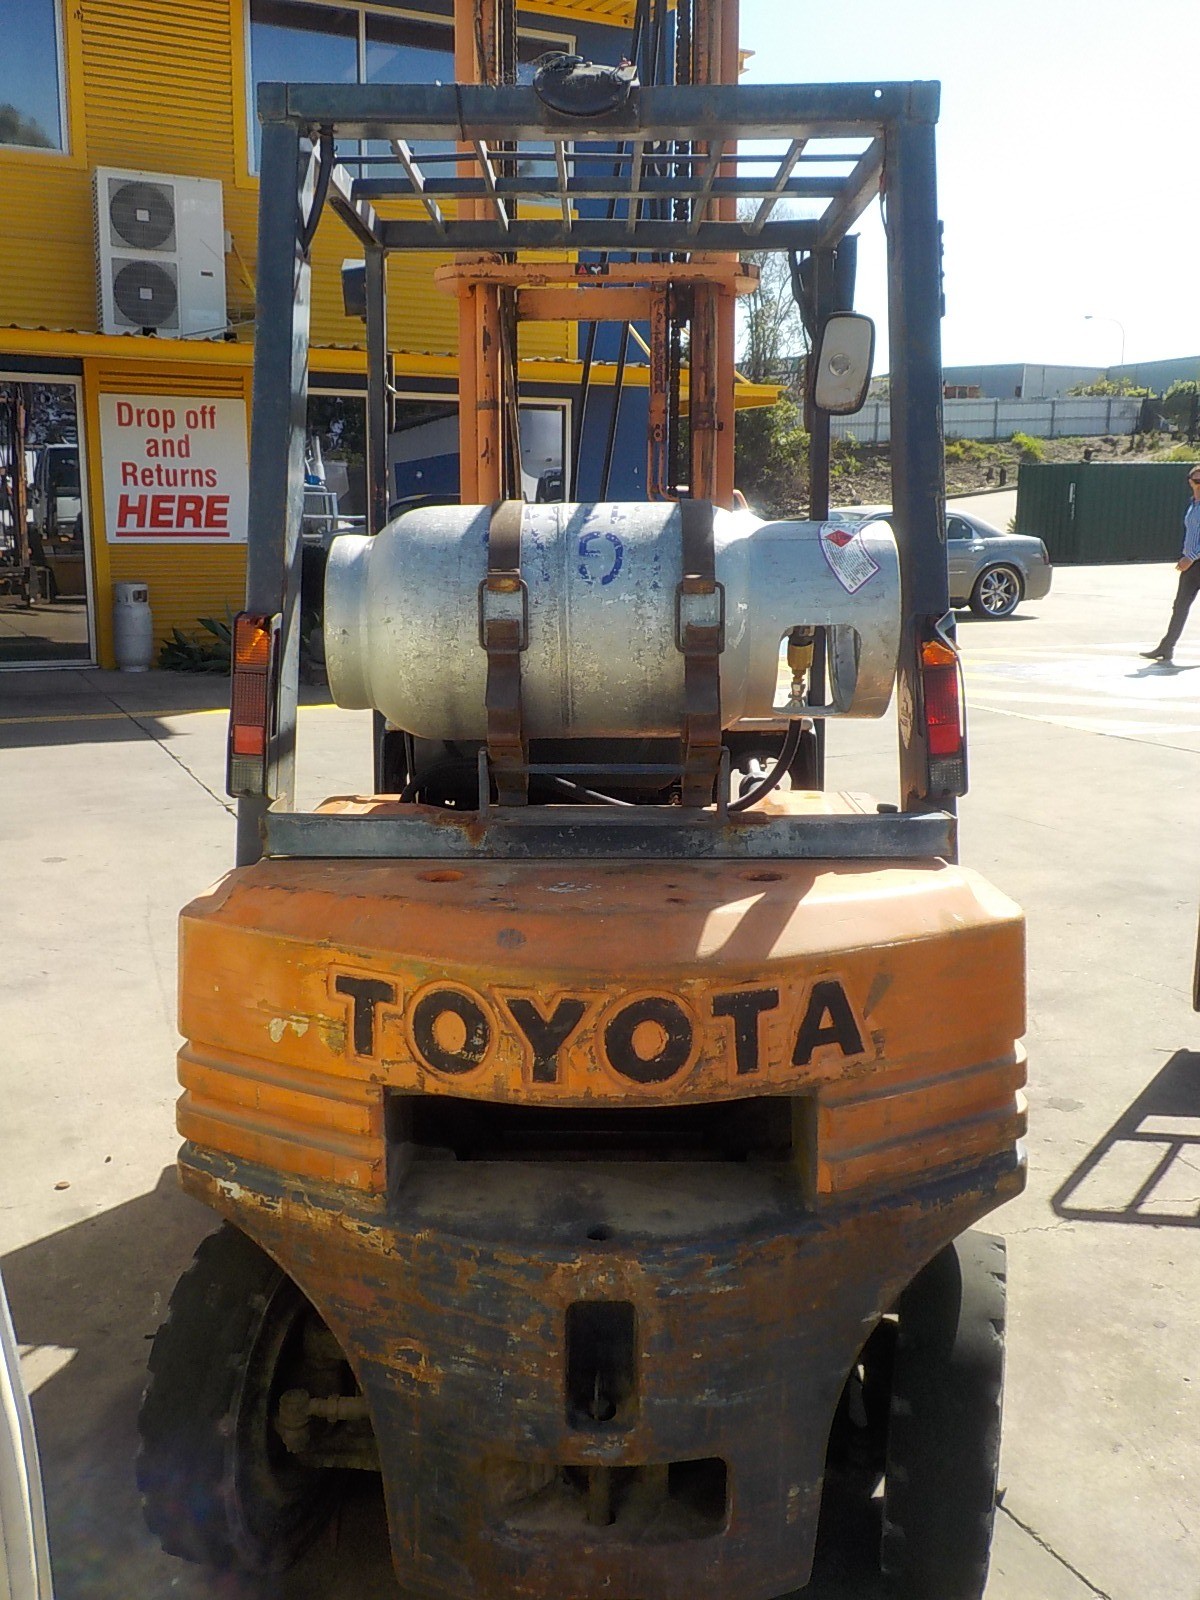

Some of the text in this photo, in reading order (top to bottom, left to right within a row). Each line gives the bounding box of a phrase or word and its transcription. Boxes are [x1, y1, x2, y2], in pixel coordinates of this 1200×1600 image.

[116, 401, 216, 434] Drop off
[145, 433, 191, 458] and
[121, 461, 218, 488] Returns
[117, 494, 230, 528] HERE
[335, 976, 865, 1083] TOYOTA
